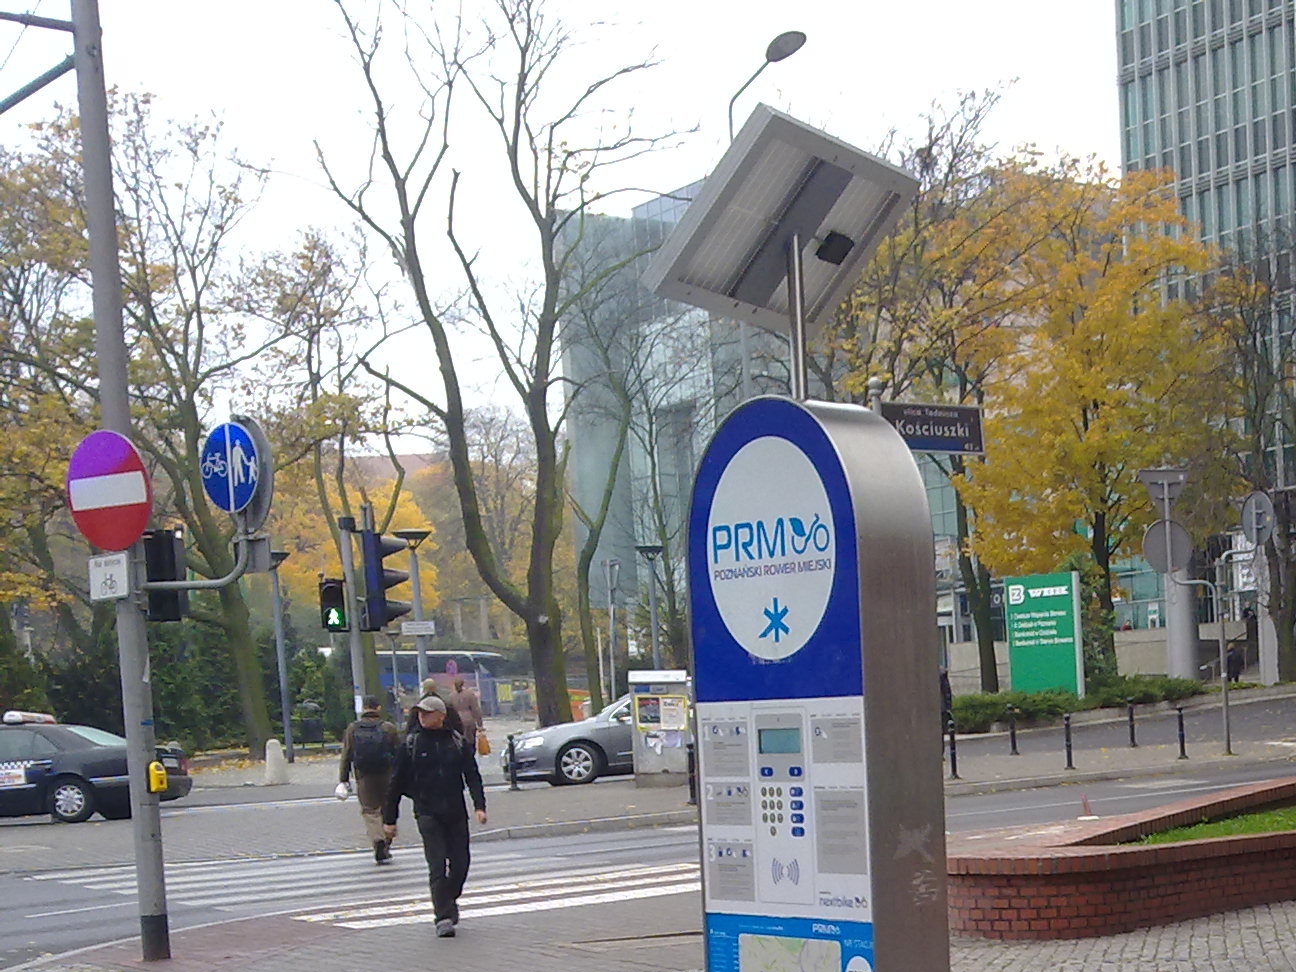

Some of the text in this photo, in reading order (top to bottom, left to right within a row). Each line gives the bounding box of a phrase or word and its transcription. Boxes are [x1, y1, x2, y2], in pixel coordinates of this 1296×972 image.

[895, 419, 969, 437] Kościuszki
[712, 517, 786, 564] PRM
[714, 558, 832, 581] POZNAŃSKI ROWER MIEJSKI
